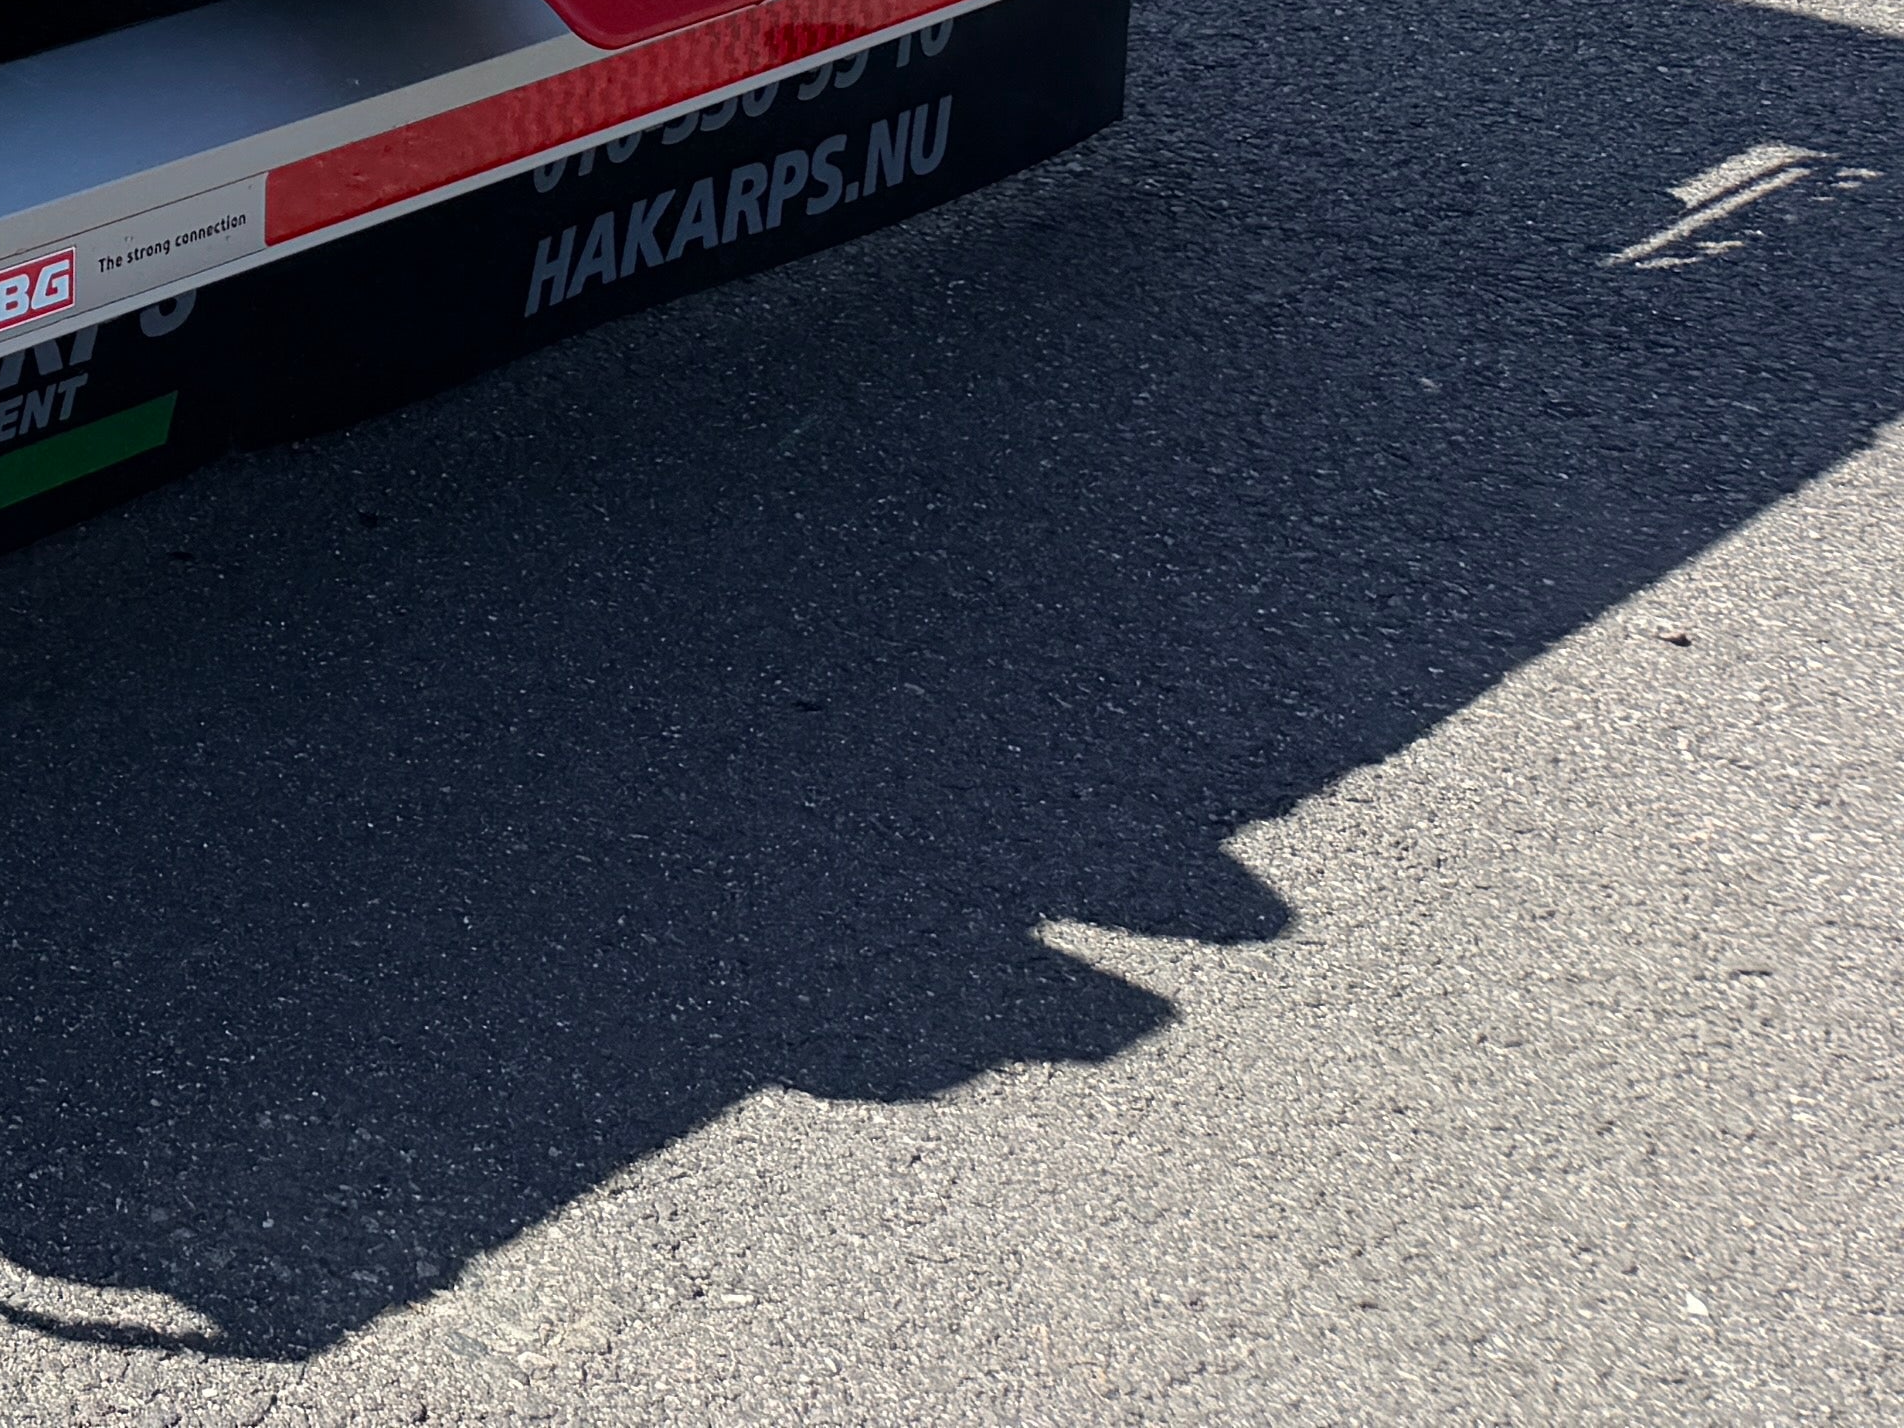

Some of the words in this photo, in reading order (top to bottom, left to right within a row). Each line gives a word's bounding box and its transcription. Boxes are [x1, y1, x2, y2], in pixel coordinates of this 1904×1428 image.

[97, 253, 123, 274] The
[125, 238, 171, 265] strong
[174, 212, 247, 250] connection
[523, 93, 953, 318] HAKARPS.NU
